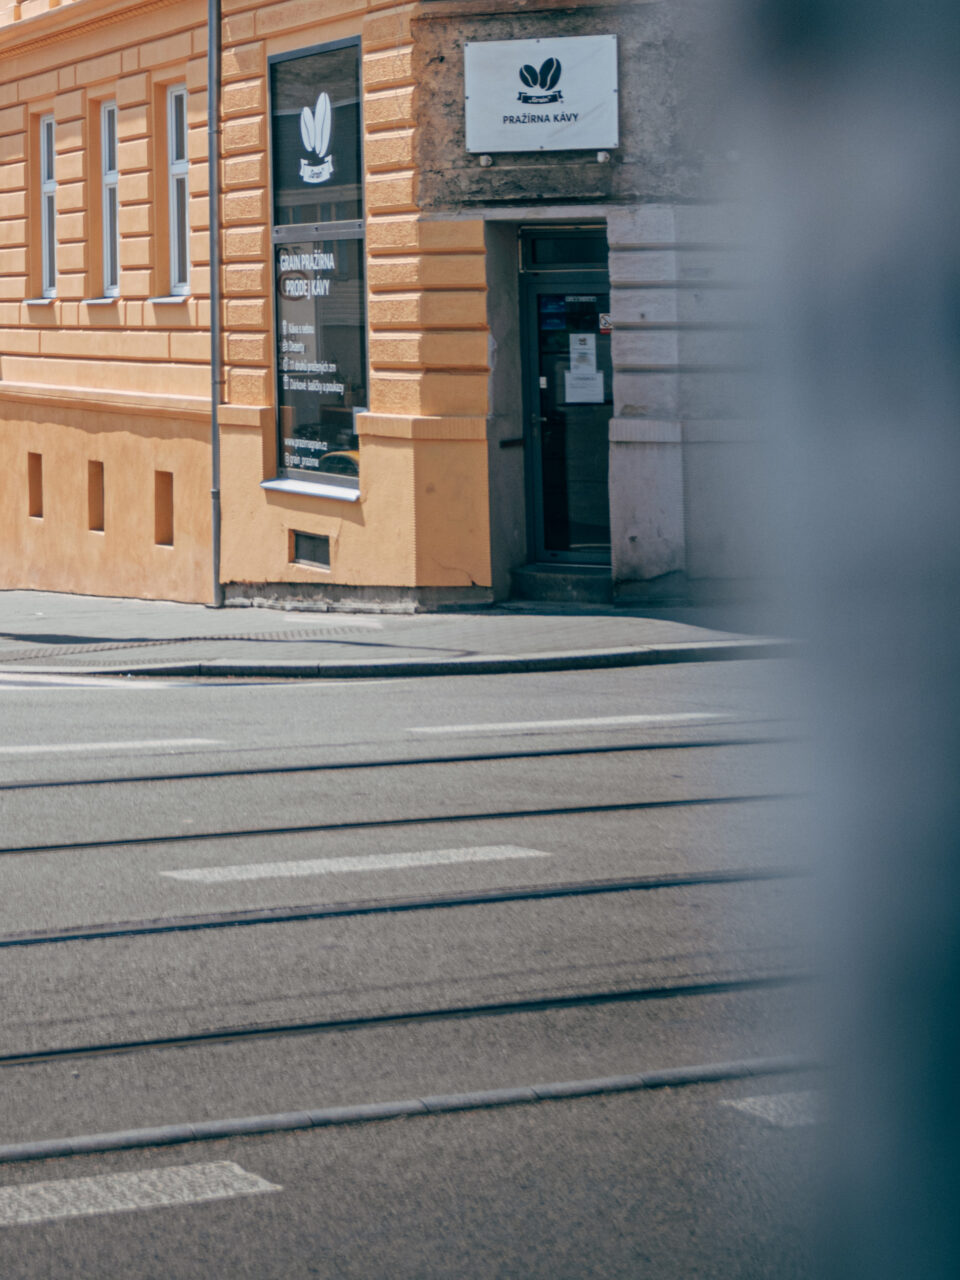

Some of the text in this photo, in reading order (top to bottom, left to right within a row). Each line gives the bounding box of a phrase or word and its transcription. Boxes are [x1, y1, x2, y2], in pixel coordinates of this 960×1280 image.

[502, 111, 579, 125] PRAŽÍRNA KÁVY
[280, 250, 335, 271] GRAIN PRAŽÍRNA
[285, 275, 330, 300] PRODEJ KÁVY
